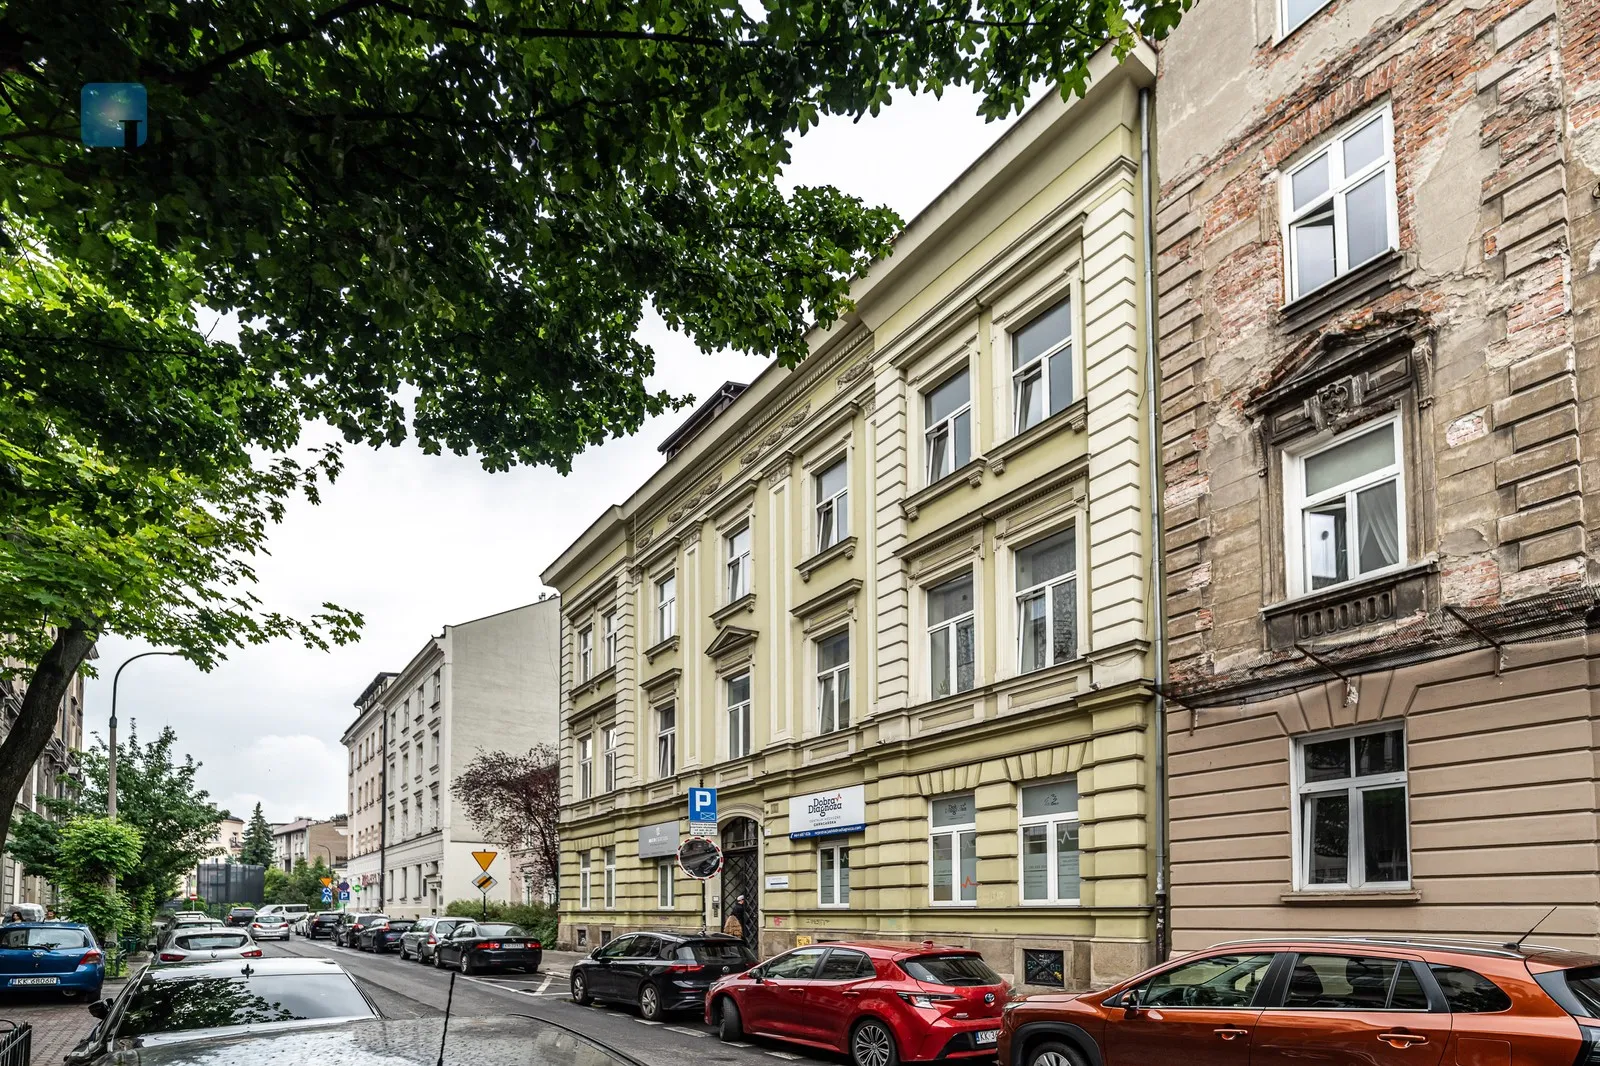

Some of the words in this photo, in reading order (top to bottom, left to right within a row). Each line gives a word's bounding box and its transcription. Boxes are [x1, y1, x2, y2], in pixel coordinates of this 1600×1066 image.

[695, 790, 711, 811] P
[813, 797, 836, 807] Dobra
[808, 802, 842, 817] Diagnoza
[341, 892, 348, 900] P
[980, 1031, 990, 1042] KK
